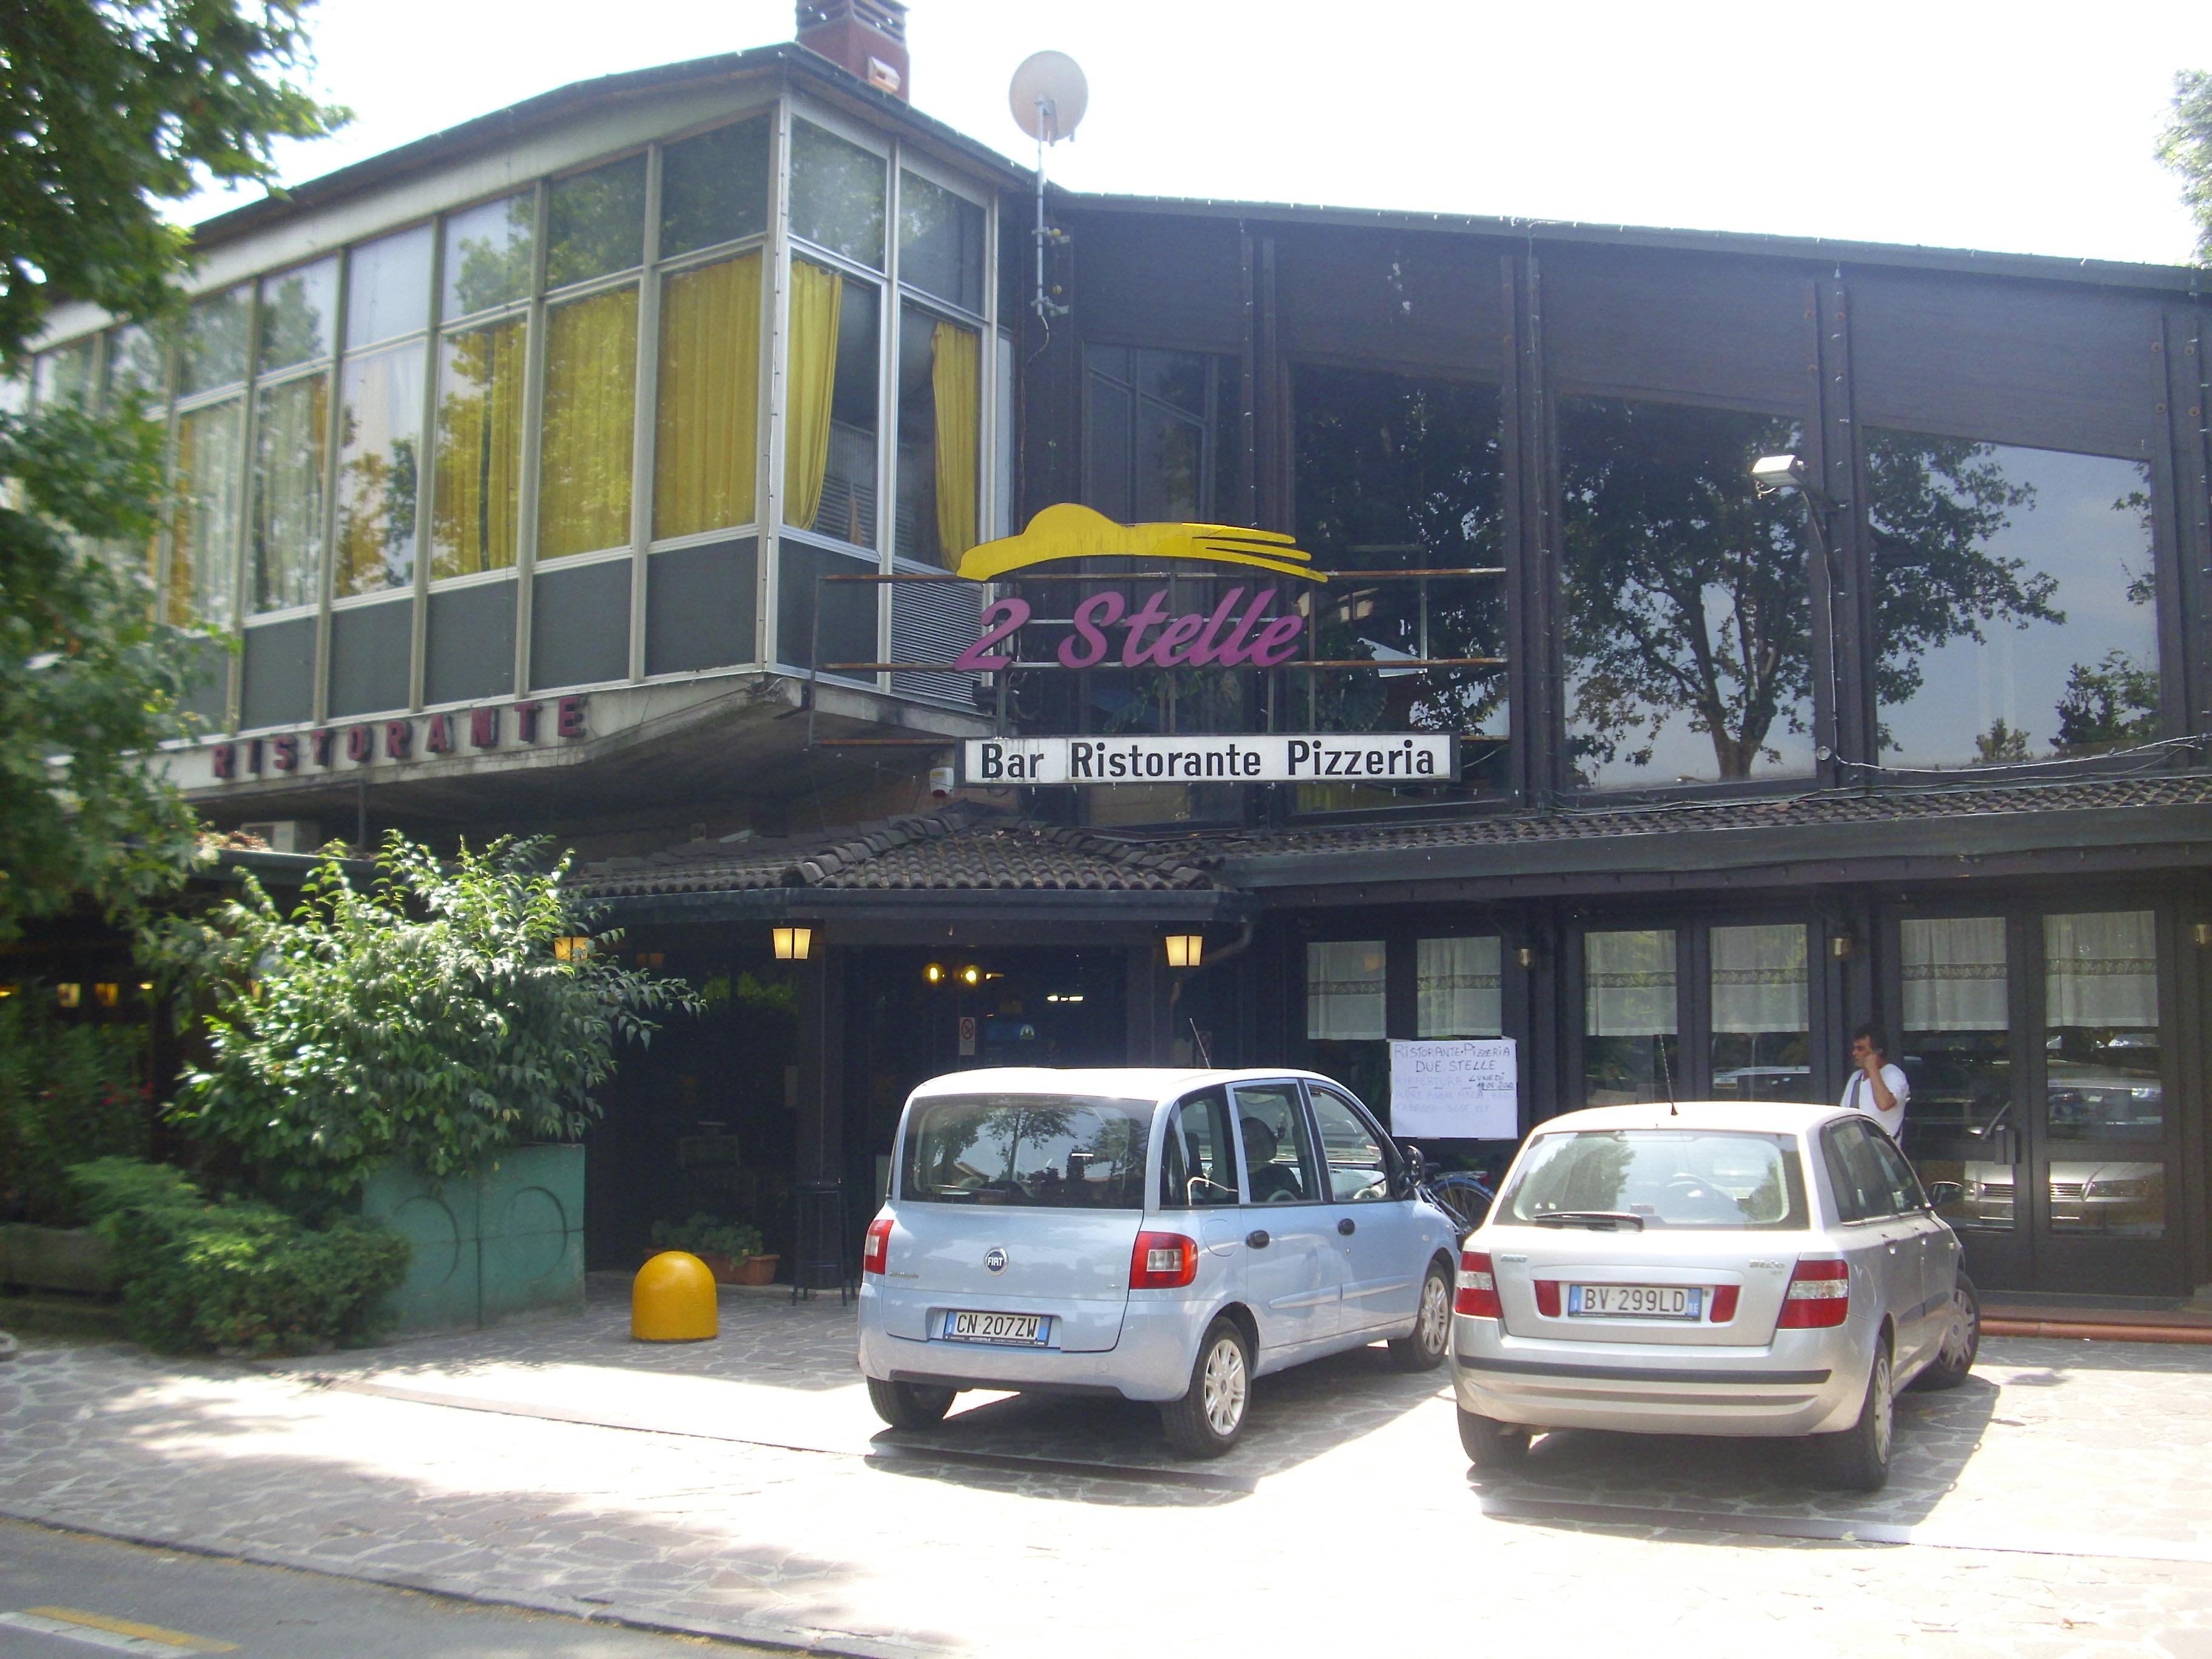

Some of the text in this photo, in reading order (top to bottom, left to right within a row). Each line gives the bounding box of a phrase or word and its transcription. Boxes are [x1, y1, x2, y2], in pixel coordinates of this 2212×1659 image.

[954, 585, 1304, 671] 2 Stelle
[212, 695, 585, 779] RISTORANTE
[980, 739, 1435, 779] Bar Ristorante Pizzeria
[1416, 1060, 1496, 1073] DUE STELLE
[988, 1257, 1004, 1267] FIAT
[1584, 1288, 1685, 1312] BV 299LD
[956, 1314, 1038, 1338] CN 207ZW
